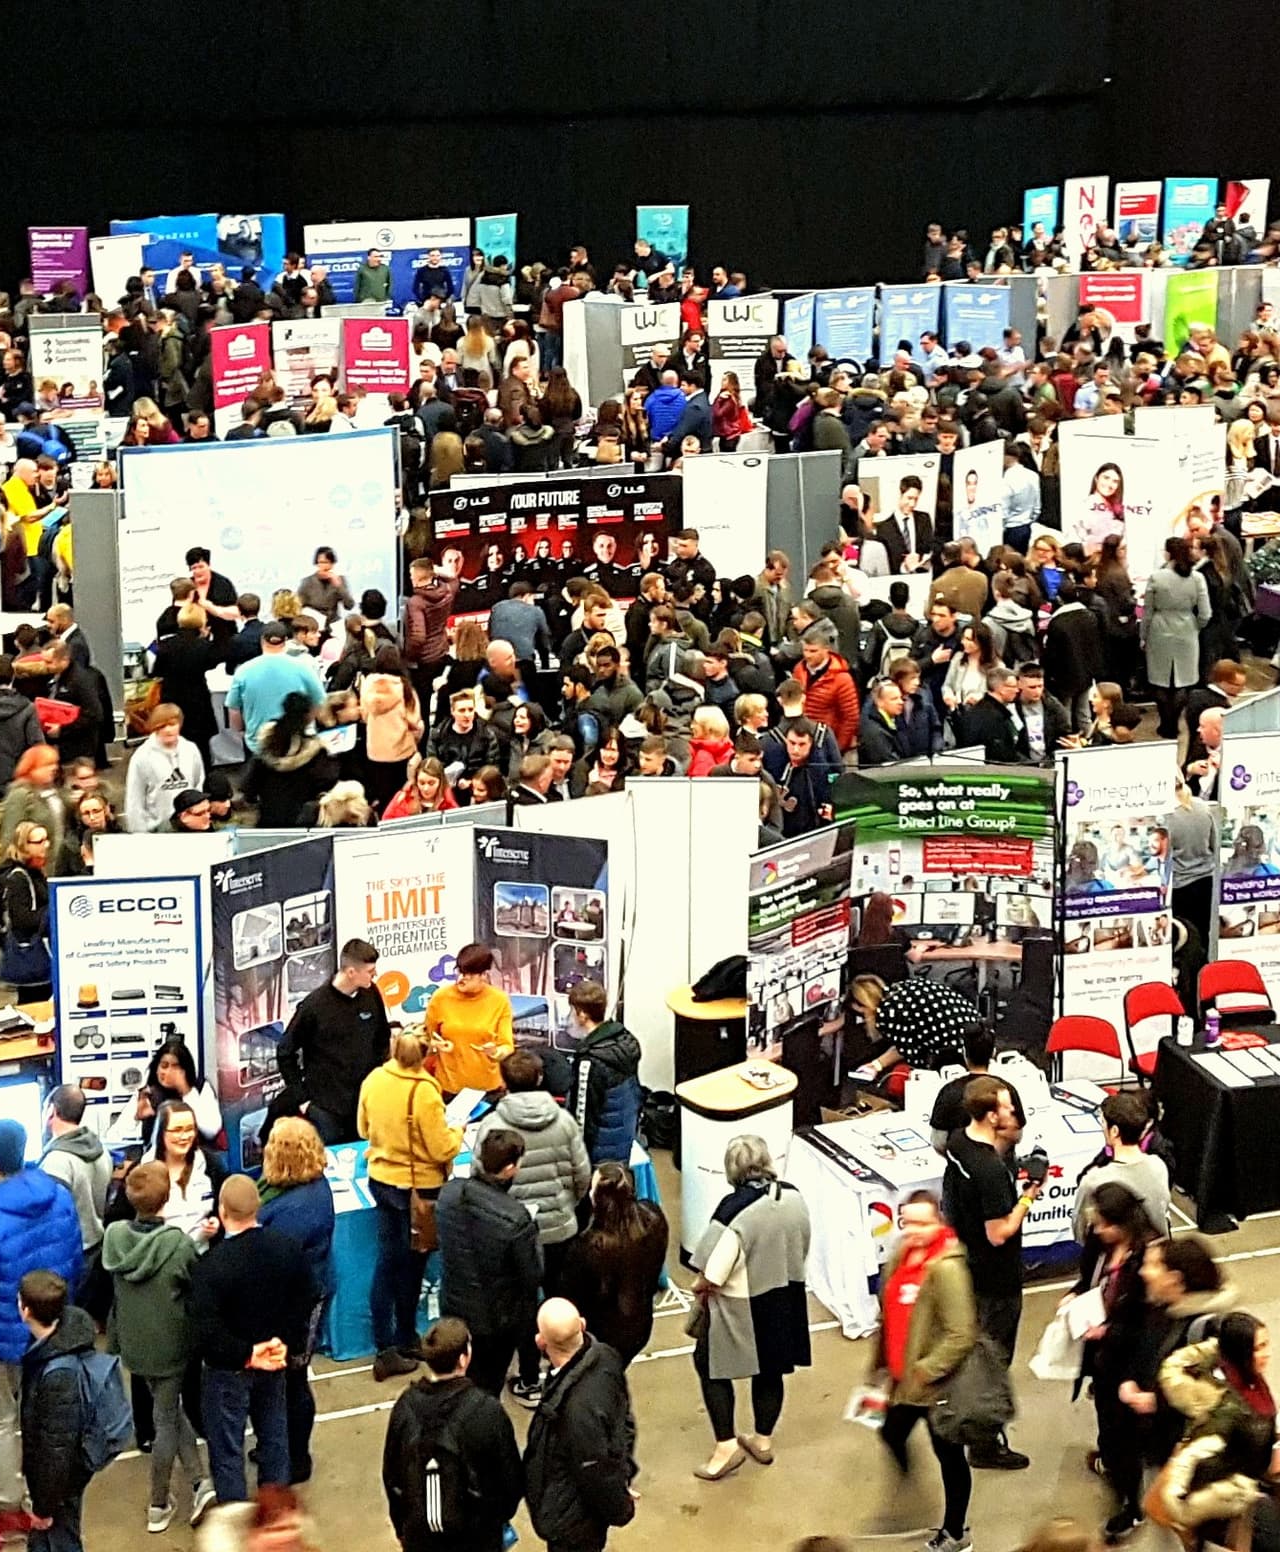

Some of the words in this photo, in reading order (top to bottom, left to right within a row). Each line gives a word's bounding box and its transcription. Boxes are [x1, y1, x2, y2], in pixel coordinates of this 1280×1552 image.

[538, 489, 581, 509] FUTURE
[898, 783, 922, 799] So,
[923, 782, 964, 797] what
[966, 783, 1011, 801] really
[898, 801, 934, 815] goes
[936, 800, 957, 811] on
[958, 799, 977, 811] at
[898, 815, 936, 829] Direct
[938, 815, 964, 829] Line
[966, 813, 1017, 832] Group?
[366, 880, 385, 891] THE
[390, 876, 422, 889] SKY'S
[425, 871, 446, 884] THE
[1223, 879, 1265, 891] Providing
[98, 896, 178, 914] ECCO
[365, 884, 446, 924] LIMIT
[1223, 892, 1234, 902] to
[1235, 891, 1251, 901] the
[366, 923, 390, 936] WITH
[391, 916, 446, 931] INTERSERVE
[83, 939, 115, 948] Leading
[367, 926, 447, 948] APPRENTICE
[65, 951, 75, 959] of
[125, 947, 153, 955] Vehicle
[377, 940, 448, 959] ROGRAMMES
[88, 961, 104, 969] and
[106, 959, 131, 967] Safety
[133, 958, 167, 966] Products
[1048, 1183, 1078, 1199] Our
[1025, 1206, 1074, 1224] tunitie
